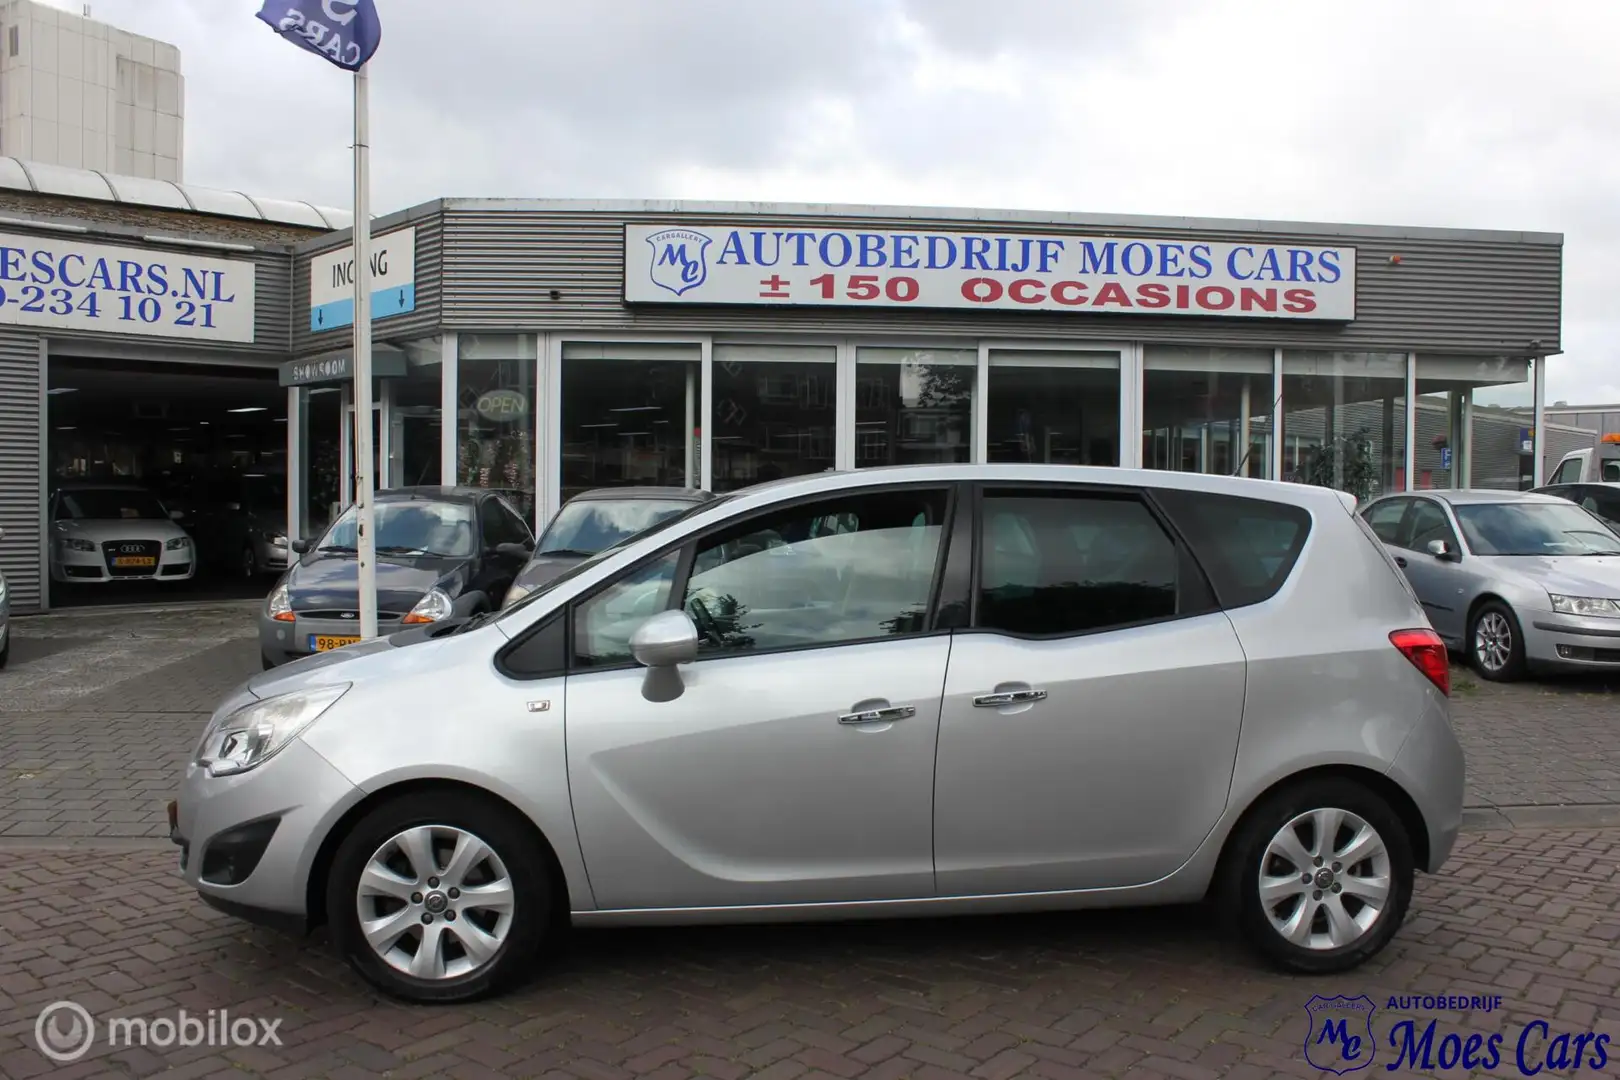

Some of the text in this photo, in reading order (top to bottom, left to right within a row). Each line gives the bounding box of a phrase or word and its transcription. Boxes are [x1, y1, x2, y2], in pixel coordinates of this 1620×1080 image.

[656, 232, 703, 243] CARGALLERY
[716, 230, 1342, 284] AUTOBEDRIJF MOES CARS
[0, 246, 236, 303] ESCARS.NL
[332, 249, 388, 288] INGNG
[0, 285, 217, 328] -234 10 21
[809, 273, 920, 302] 150
[961, 276, 1318, 313] OCCASIONS
[292, 359, 346, 381] SHOWROOM
[476, 396, 525, 413] OPEN
